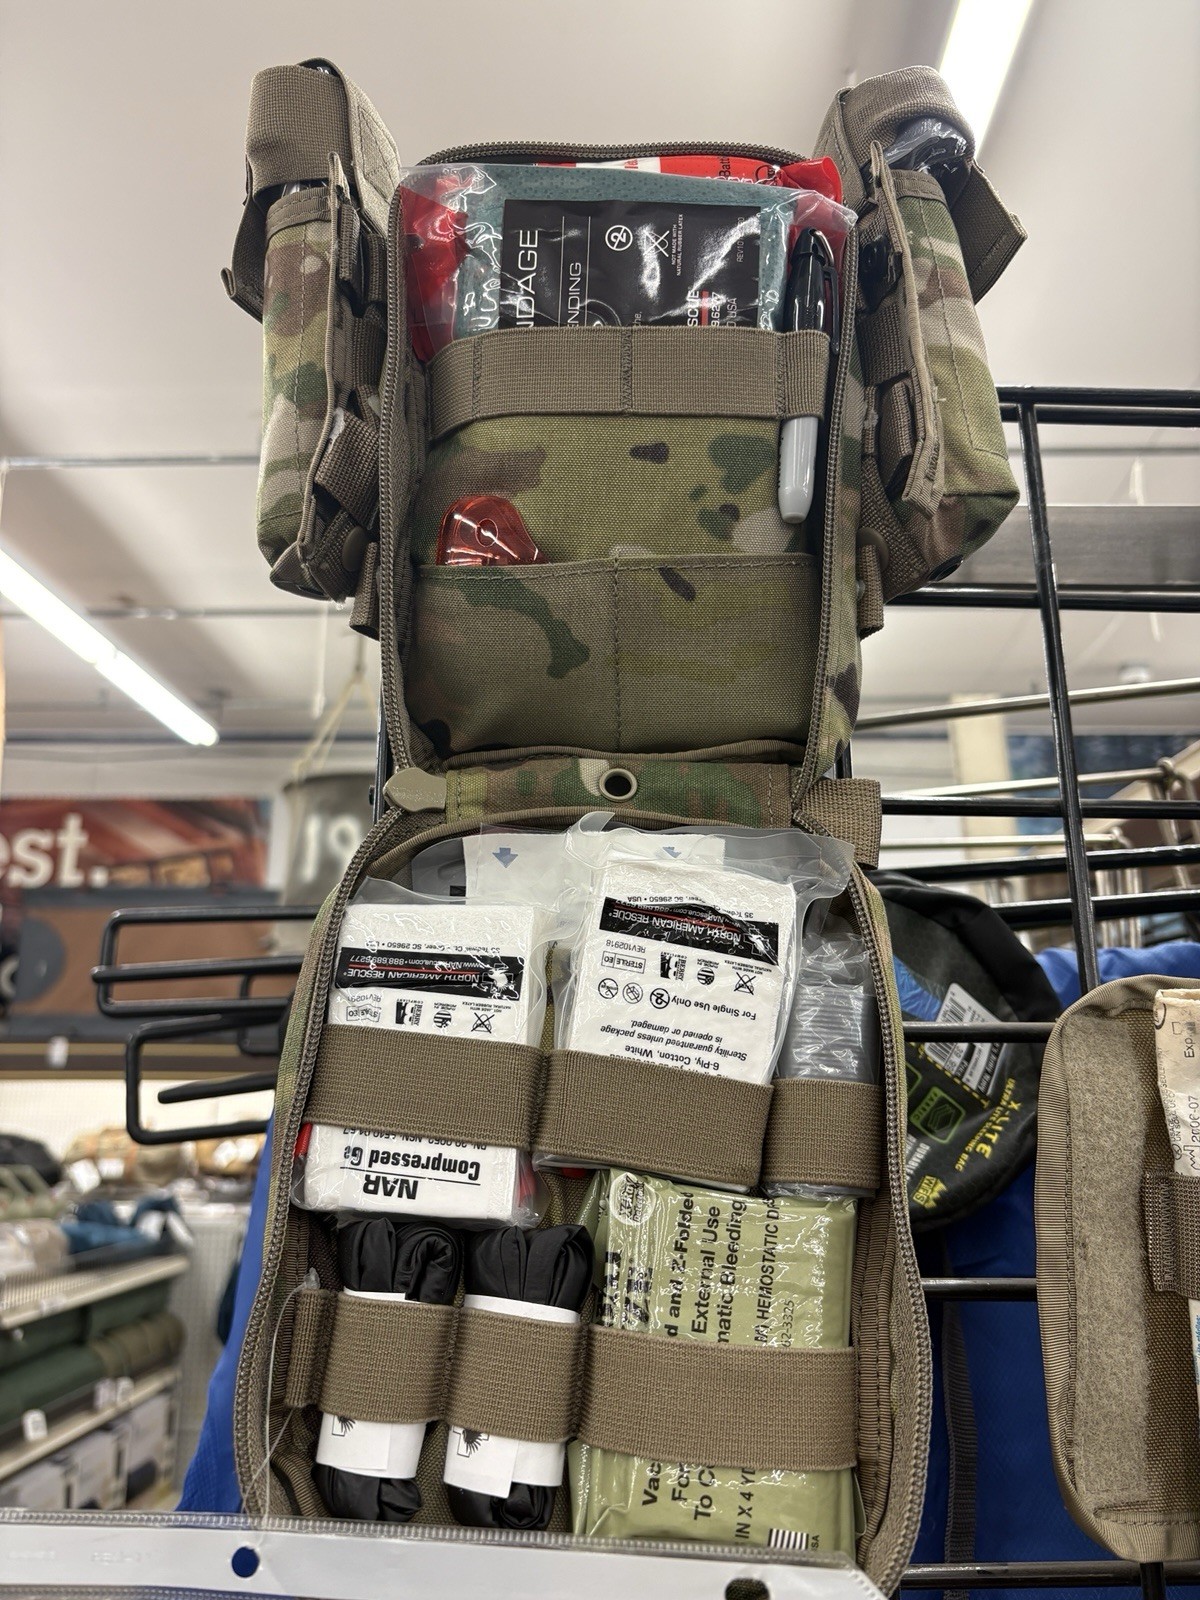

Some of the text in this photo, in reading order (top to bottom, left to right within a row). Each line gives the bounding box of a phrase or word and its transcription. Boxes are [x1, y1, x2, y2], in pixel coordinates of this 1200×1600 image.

[568, 262, 581, 327] NDING
[0, 813, 109, 889] st.
[652, 916, 704, 937] AMERICAN
[387, 941, 411, 949] 29650
[606, 939, 646, 953] REV102918
[616, 958, 643, 969] STERILE
[678, 959, 686, 981] BERRY
[388, 971, 441, 980] AMERICAN
[443, 973, 479, 983] NORTH
[413, 1004, 423, 1026] BERRY
[671, 995, 756, 1020] For Single Use Only
[600, 1025, 747, 1061] Sterility guaranteed unless package
[630, 1019, 722, 1045] is opened or damaged.
[624, 1045, 653, 1058] White
[657, 1050, 691, 1065] Cotton,
[695, 1056, 719, 1071] 6-Ply,
[976, 1100, 1021, 1159] X-LITE
[367, 1150, 480, 1181] Compressed
[955, 1153, 969, 1172] BAG
[362, 1174, 419, 1200] NAR
[719, 1200, 747, 1285] Bleeding
[691, 1206, 721, 1333] External Use
[756, 1224, 779, 1319] HEMOSTATIC
[666, 1280, 684, 1318] and
[694, 1495, 713, 1520] To
[739, 1492, 754, 1501] 4
[737, 1506, 753, 1518] X
[734, 1523, 751, 1539] IN
